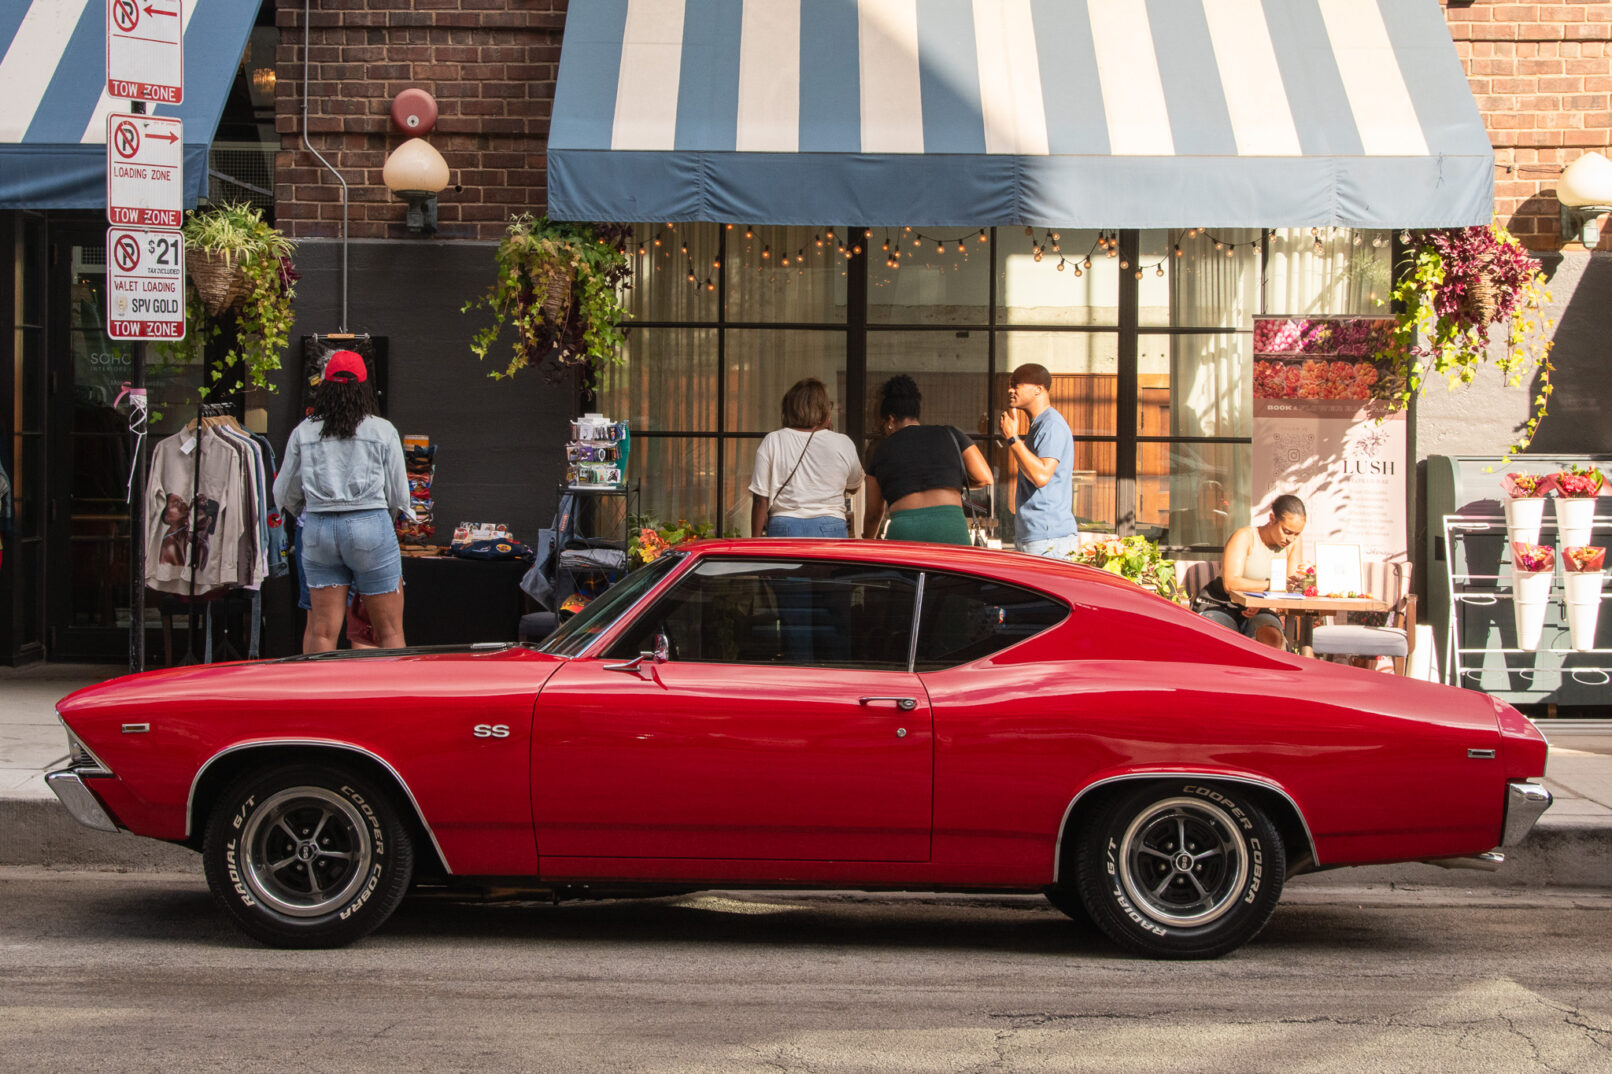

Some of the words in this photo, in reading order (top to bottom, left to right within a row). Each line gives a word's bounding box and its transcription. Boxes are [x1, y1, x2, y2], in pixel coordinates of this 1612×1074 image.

[112, 81, 138, 97] TOW
[143, 84, 177, 101] ZONE
[113, 167, 147, 179] LOADING
[151, 170, 171, 181] ZONE
[114, 208, 139, 222] TOW
[144, 210, 177, 225] ZONE
[148, 238, 179, 266] $21
[113, 280, 138, 291] VALET
[142, 281, 176, 293] LOADING
[132, 298, 151, 313] SPV
[153, 299, 179, 313] GOLD
[113, 321, 140, 336] TOW
[146, 322, 178, 336] ZONE
[1343, 460, 1395, 475] LUSH
[473, 724, 510, 738] SS
[233, 794, 255, 830] G/T
[340, 785, 384, 855] COOPER
[1183, 785, 1253, 830] COOPER
[1244, 837, 1263, 904] COBRA
[226, 838, 255, 907] RADIAL
[339, 863, 382, 920] COBRA
[1113, 884, 1168, 937] RADIAL
